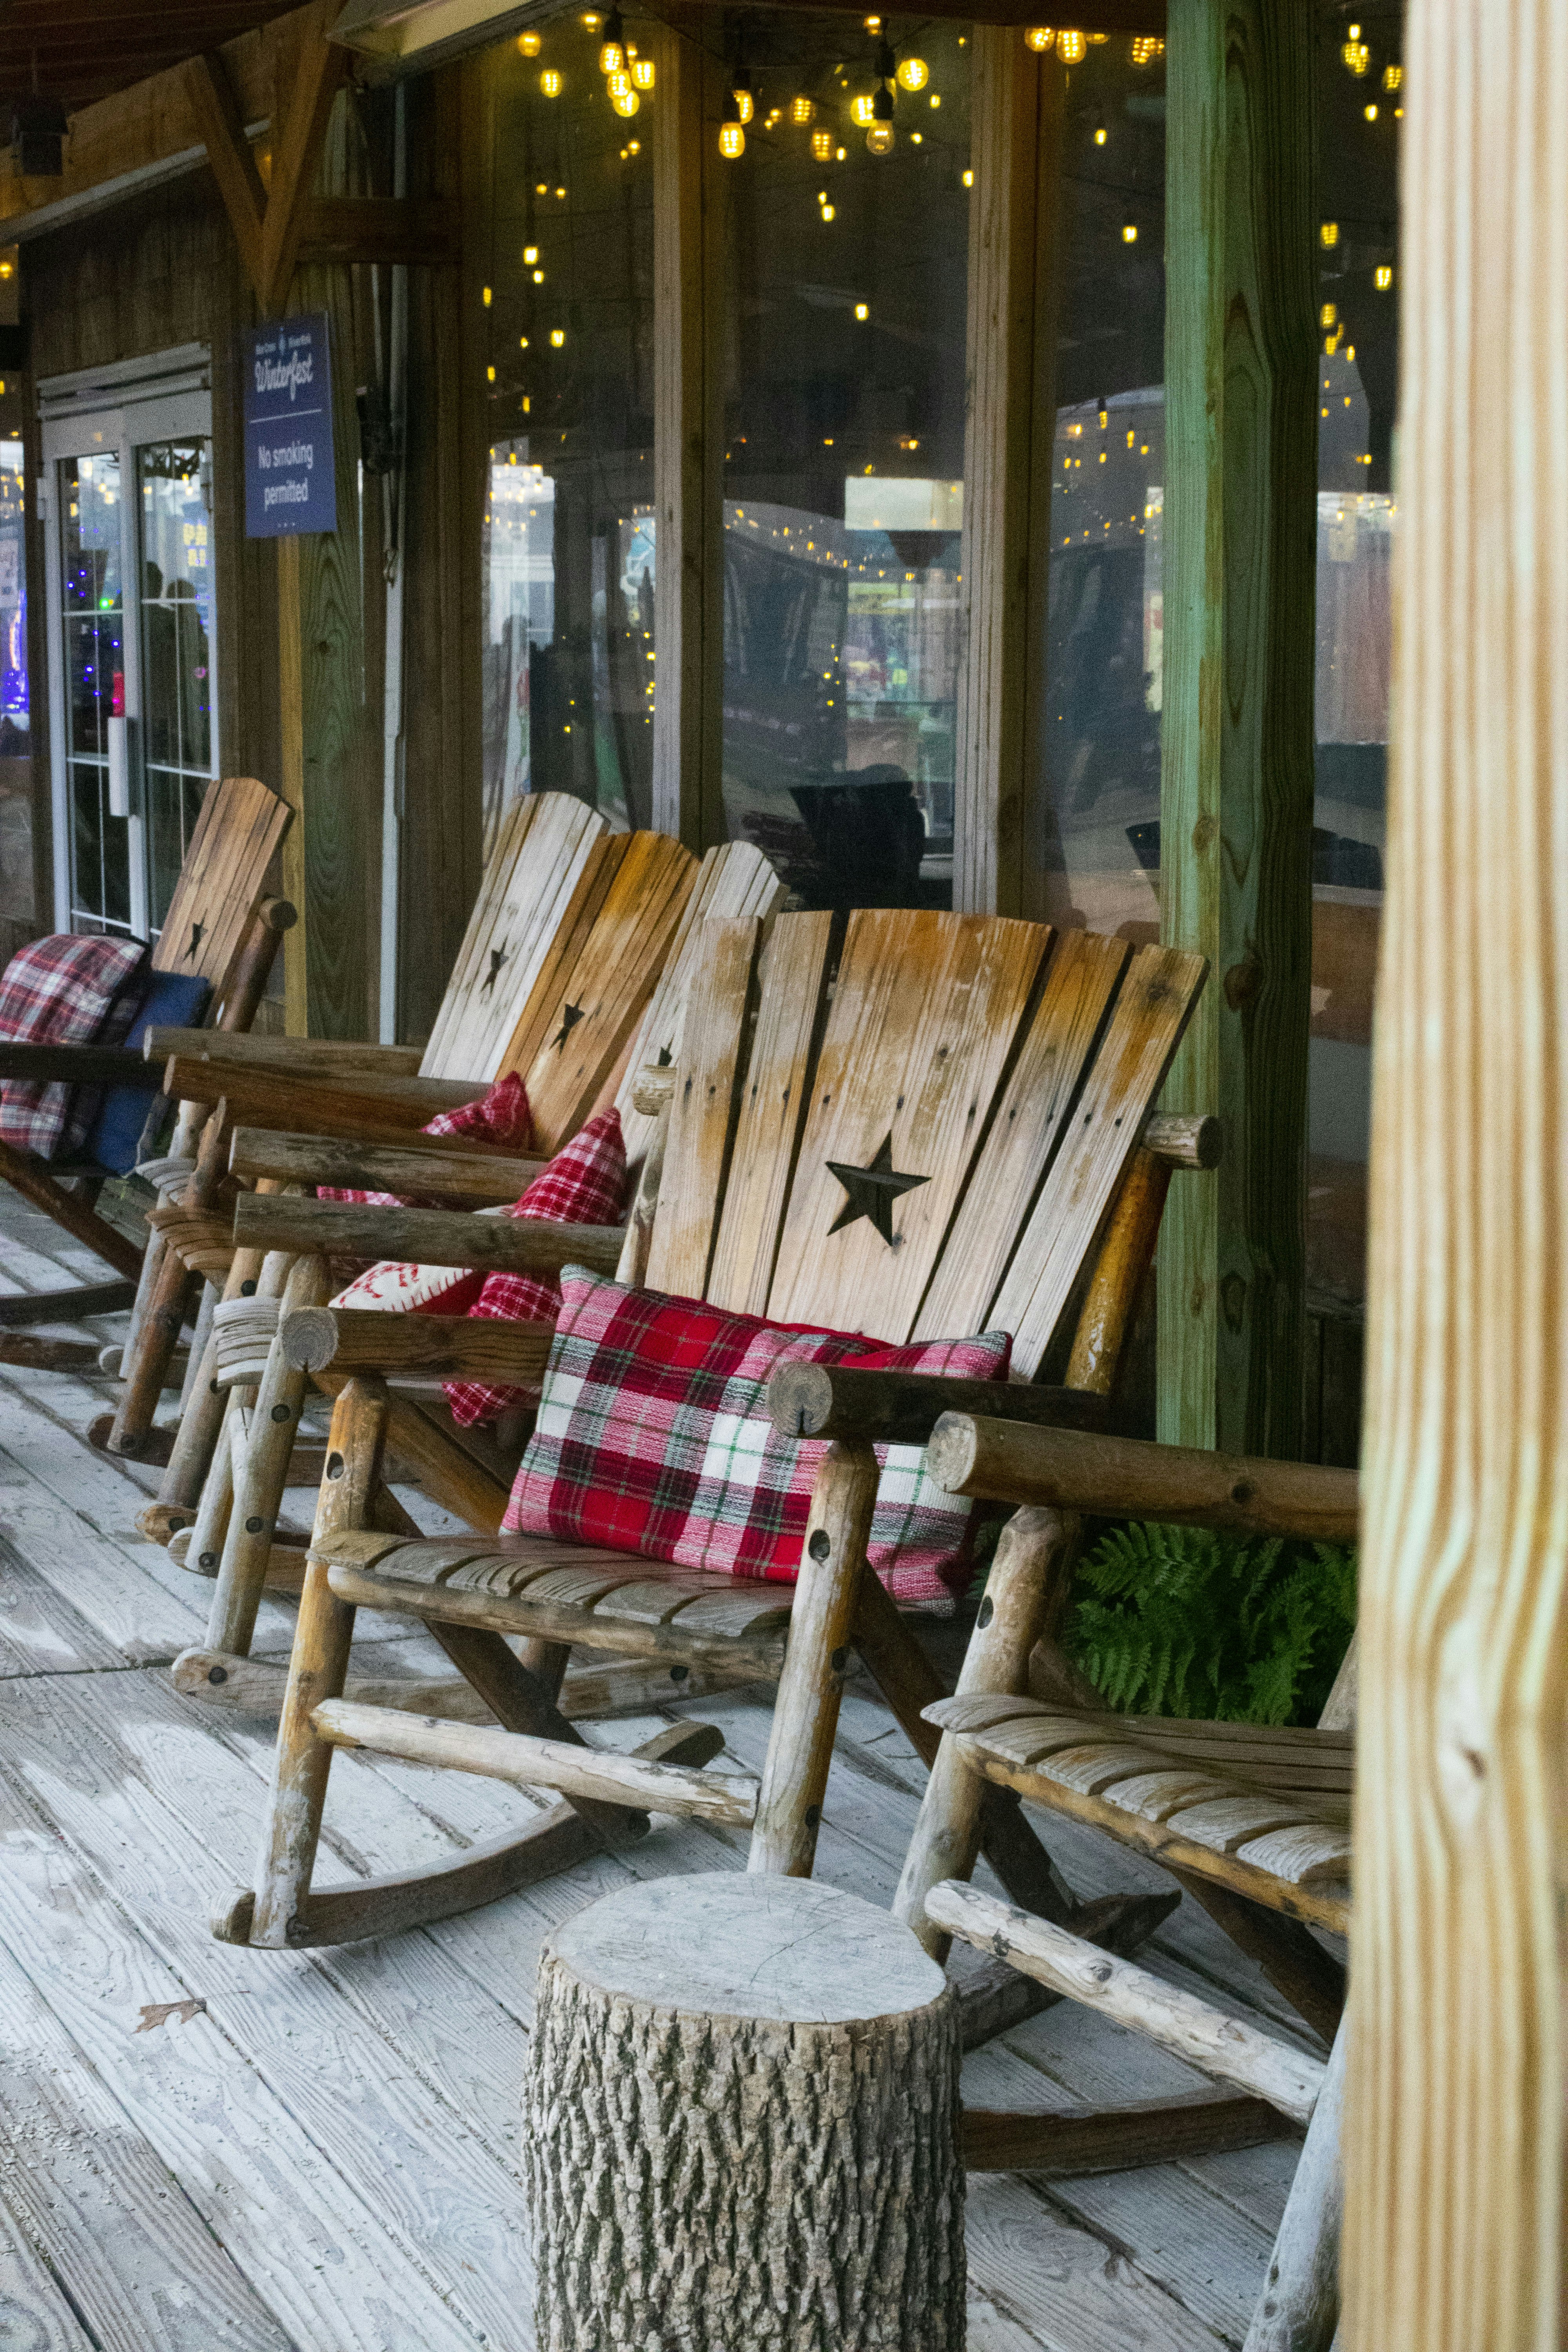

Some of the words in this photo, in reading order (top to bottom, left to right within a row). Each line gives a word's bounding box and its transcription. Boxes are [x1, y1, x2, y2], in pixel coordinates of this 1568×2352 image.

[254, 350, 313, 401] Winterfest
[258, 445, 271, 469] No
[273, 440, 313, 469] smoking
[264, 477, 309, 512] permitted
